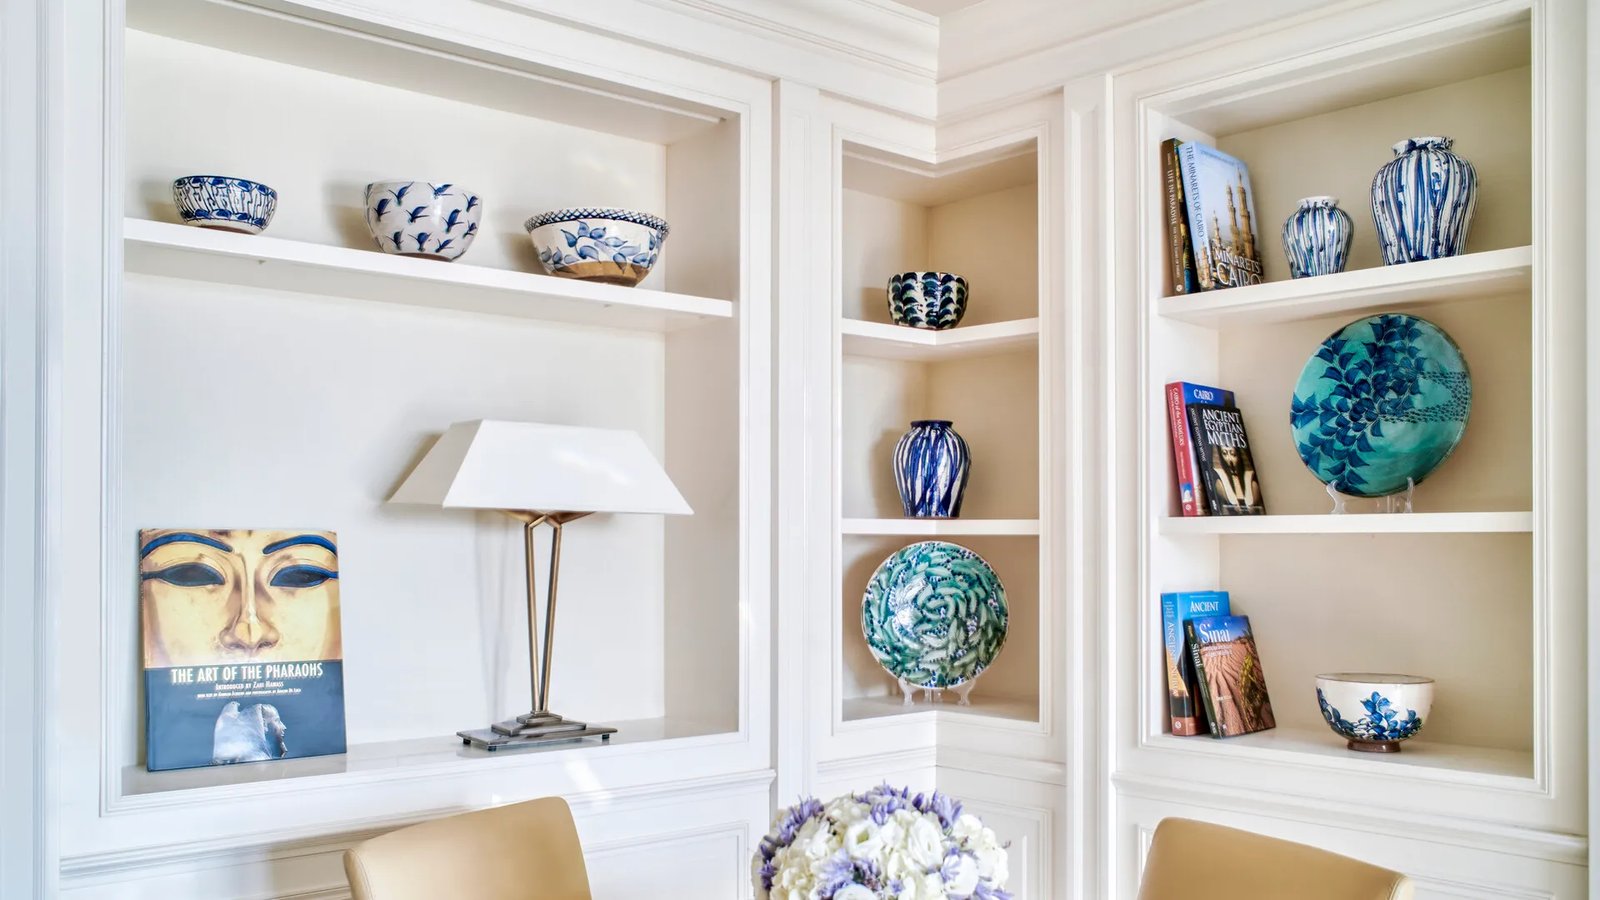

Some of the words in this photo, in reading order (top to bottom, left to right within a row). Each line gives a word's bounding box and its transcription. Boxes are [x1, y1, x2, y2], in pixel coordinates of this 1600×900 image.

[1186, 146, 1194, 162] THE
[1168, 184, 1176, 192] IN
[1188, 162, 1200, 201] MINARETS
[1193, 202, 1202, 213] OF
[1195, 213, 1205, 238] CAIRO
[1214, 248, 1260, 274] MINARETS
[1217, 262, 1261, 287] CAIRO
[1193, 388, 1214, 401] CAIRO
[1202, 408, 1239, 424] ANCIENT
[1203, 420, 1244, 435] EGYPTIAN
[1207, 430, 1247, 448] MYTHS
[1190, 601, 1219, 612] ANCIENT
[1199, 622, 1231, 644] Sinai
[1191, 643, 1203, 668] Sinai
[171, 668, 194, 684] THE
[197, 667, 219, 682] ART
[222, 666, 238, 681] OF
[241, 664, 262, 680] THE
[266, 662, 324, 678] PHARAOHS
